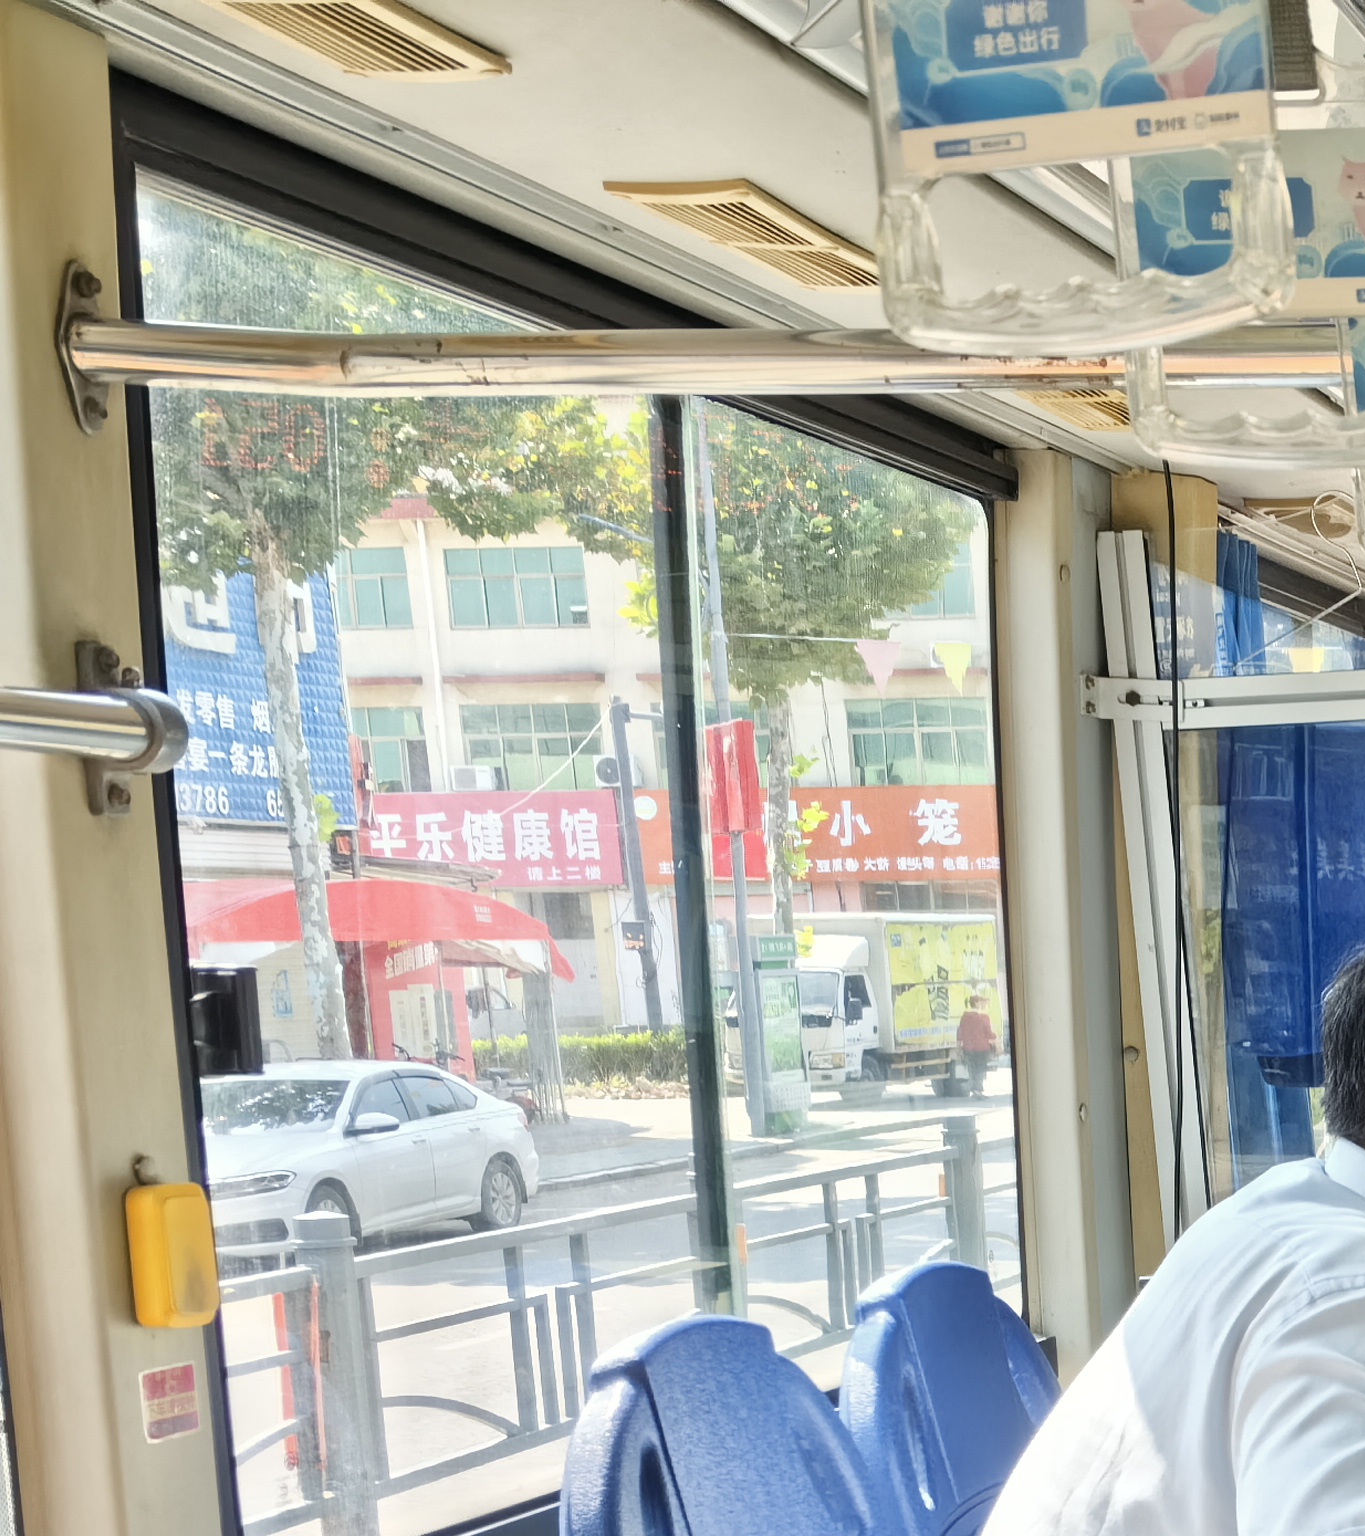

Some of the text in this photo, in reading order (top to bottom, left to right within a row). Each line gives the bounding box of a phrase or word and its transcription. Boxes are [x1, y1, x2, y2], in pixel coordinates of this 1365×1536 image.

[974, 26, 1061, 58] 绿色出行
[370, 808, 602, 862] 平乐健康馆
[527, 866, 602, 881] 请上二楼
